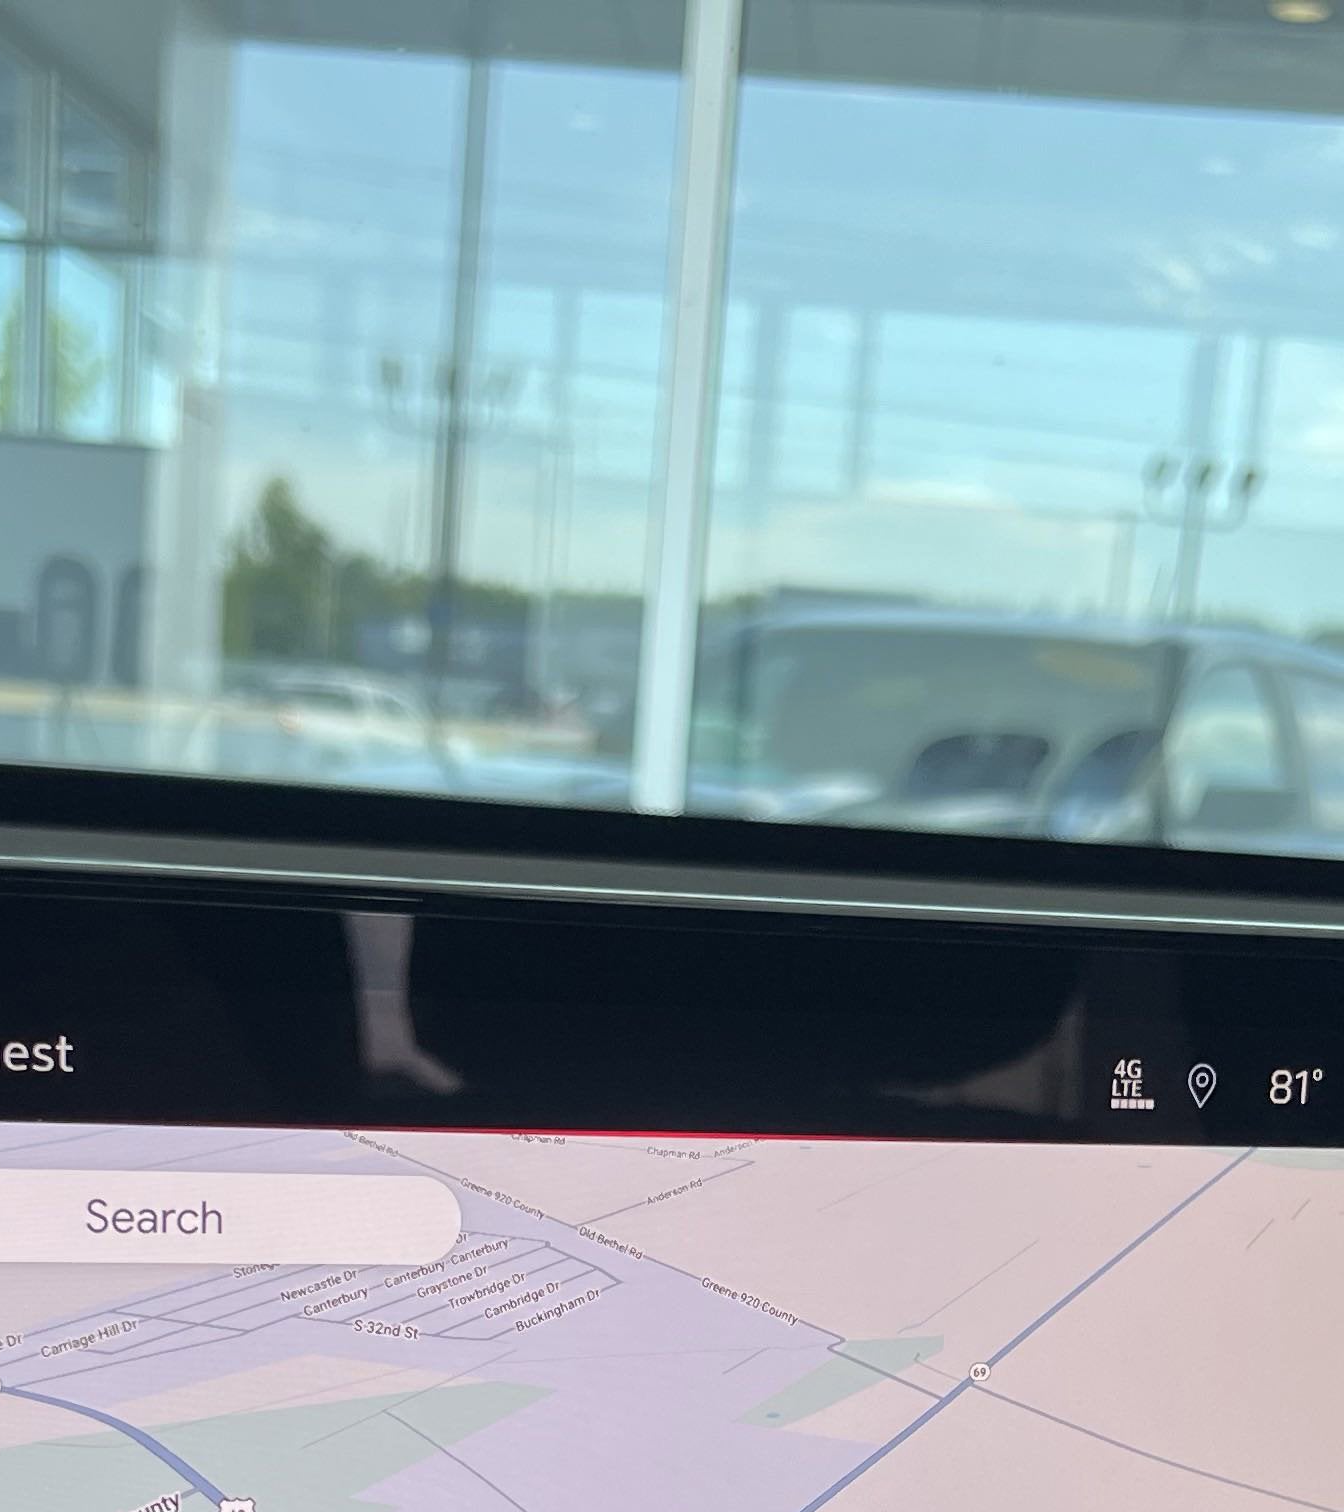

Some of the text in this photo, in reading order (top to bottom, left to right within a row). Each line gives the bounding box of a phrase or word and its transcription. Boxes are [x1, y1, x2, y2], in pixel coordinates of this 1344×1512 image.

[1114, 1059, 1143, 1078] 4G
[1111, 1078, 1143, 1097] LTE
[358, 1135, 387, 1152] Bethel
[553, 1136, 566, 1146] Rd
[646, 1146, 701, 1160] Chapman Rd
[713, 1139, 753, 1158] Anderson
[460, 1177, 546, 1220] Greene 920 County
[646, 1177, 703, 1205] Anderson Rd
[84, 1196, 225, 1237] Search
[578, 1226, 644, 1260] Old Bethel Rd
[383, 1239, 509, 1288] Canterbury Canterbury
[280, 1270, 358, 1302] Newcastle Dr
[416, 1266, 488, 1298] Graystone Dr
[447, 1272, 526, 1309] Trowbridge Dr
[303, 1287, 368, 1316] Canterbury
[484, 1281, 560, 1319] Cambridge Dr
[515, 1289, 601, 1332] Buckingham Dr
[701, 1277, 799, 1326] Greene 920 County
[6, 1333, 23, 1347] Dr
[40, 1319, 138, 1358] Carriage Hill Dr
[354, 1320, 419, 1340] S 32nd St
[972, 1365, 987, 1378] 69
